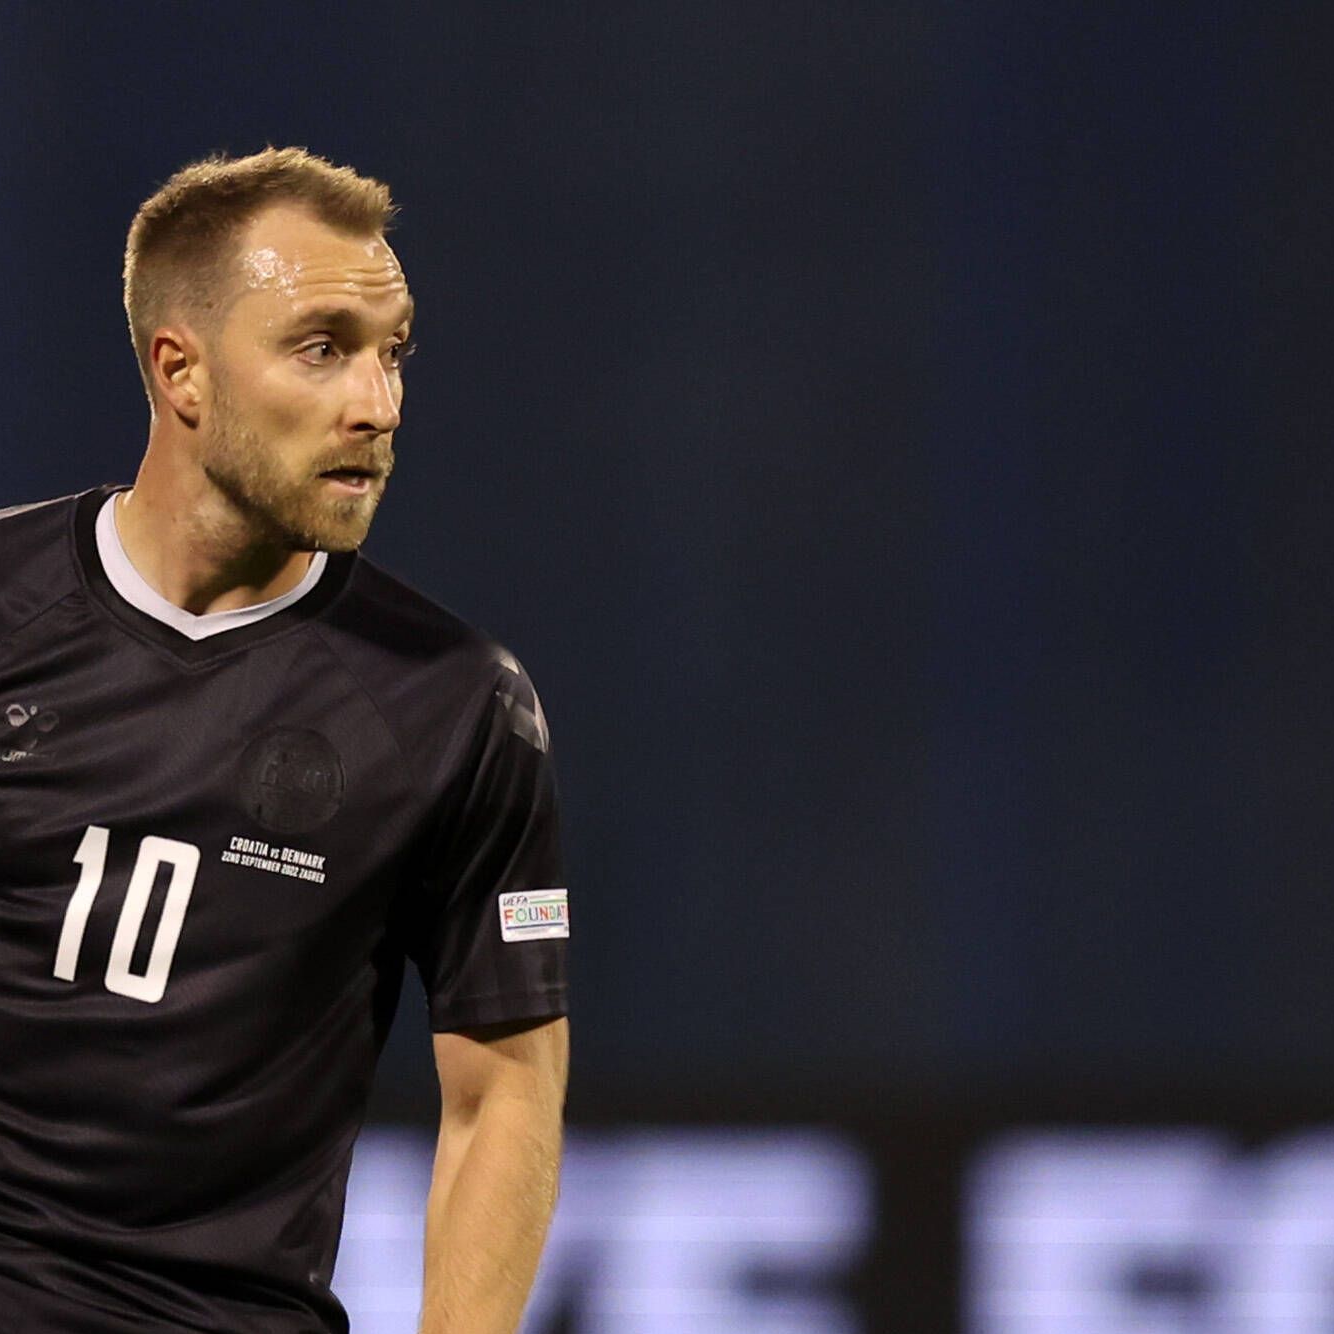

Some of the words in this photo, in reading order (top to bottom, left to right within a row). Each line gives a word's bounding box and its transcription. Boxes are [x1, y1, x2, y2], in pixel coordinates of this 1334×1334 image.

[230, 836, 269, 857] CROATIA
[281, 847, 326, 870] DENMARK
[240, 855, 282, 873] SEPTEMBER
[281, 863, 300, 878] 2022
[298, 868, 326, 884] ZAGREB
[53, 824, 201, 1004] 10
[503, 895, 528, 907] UEFA
